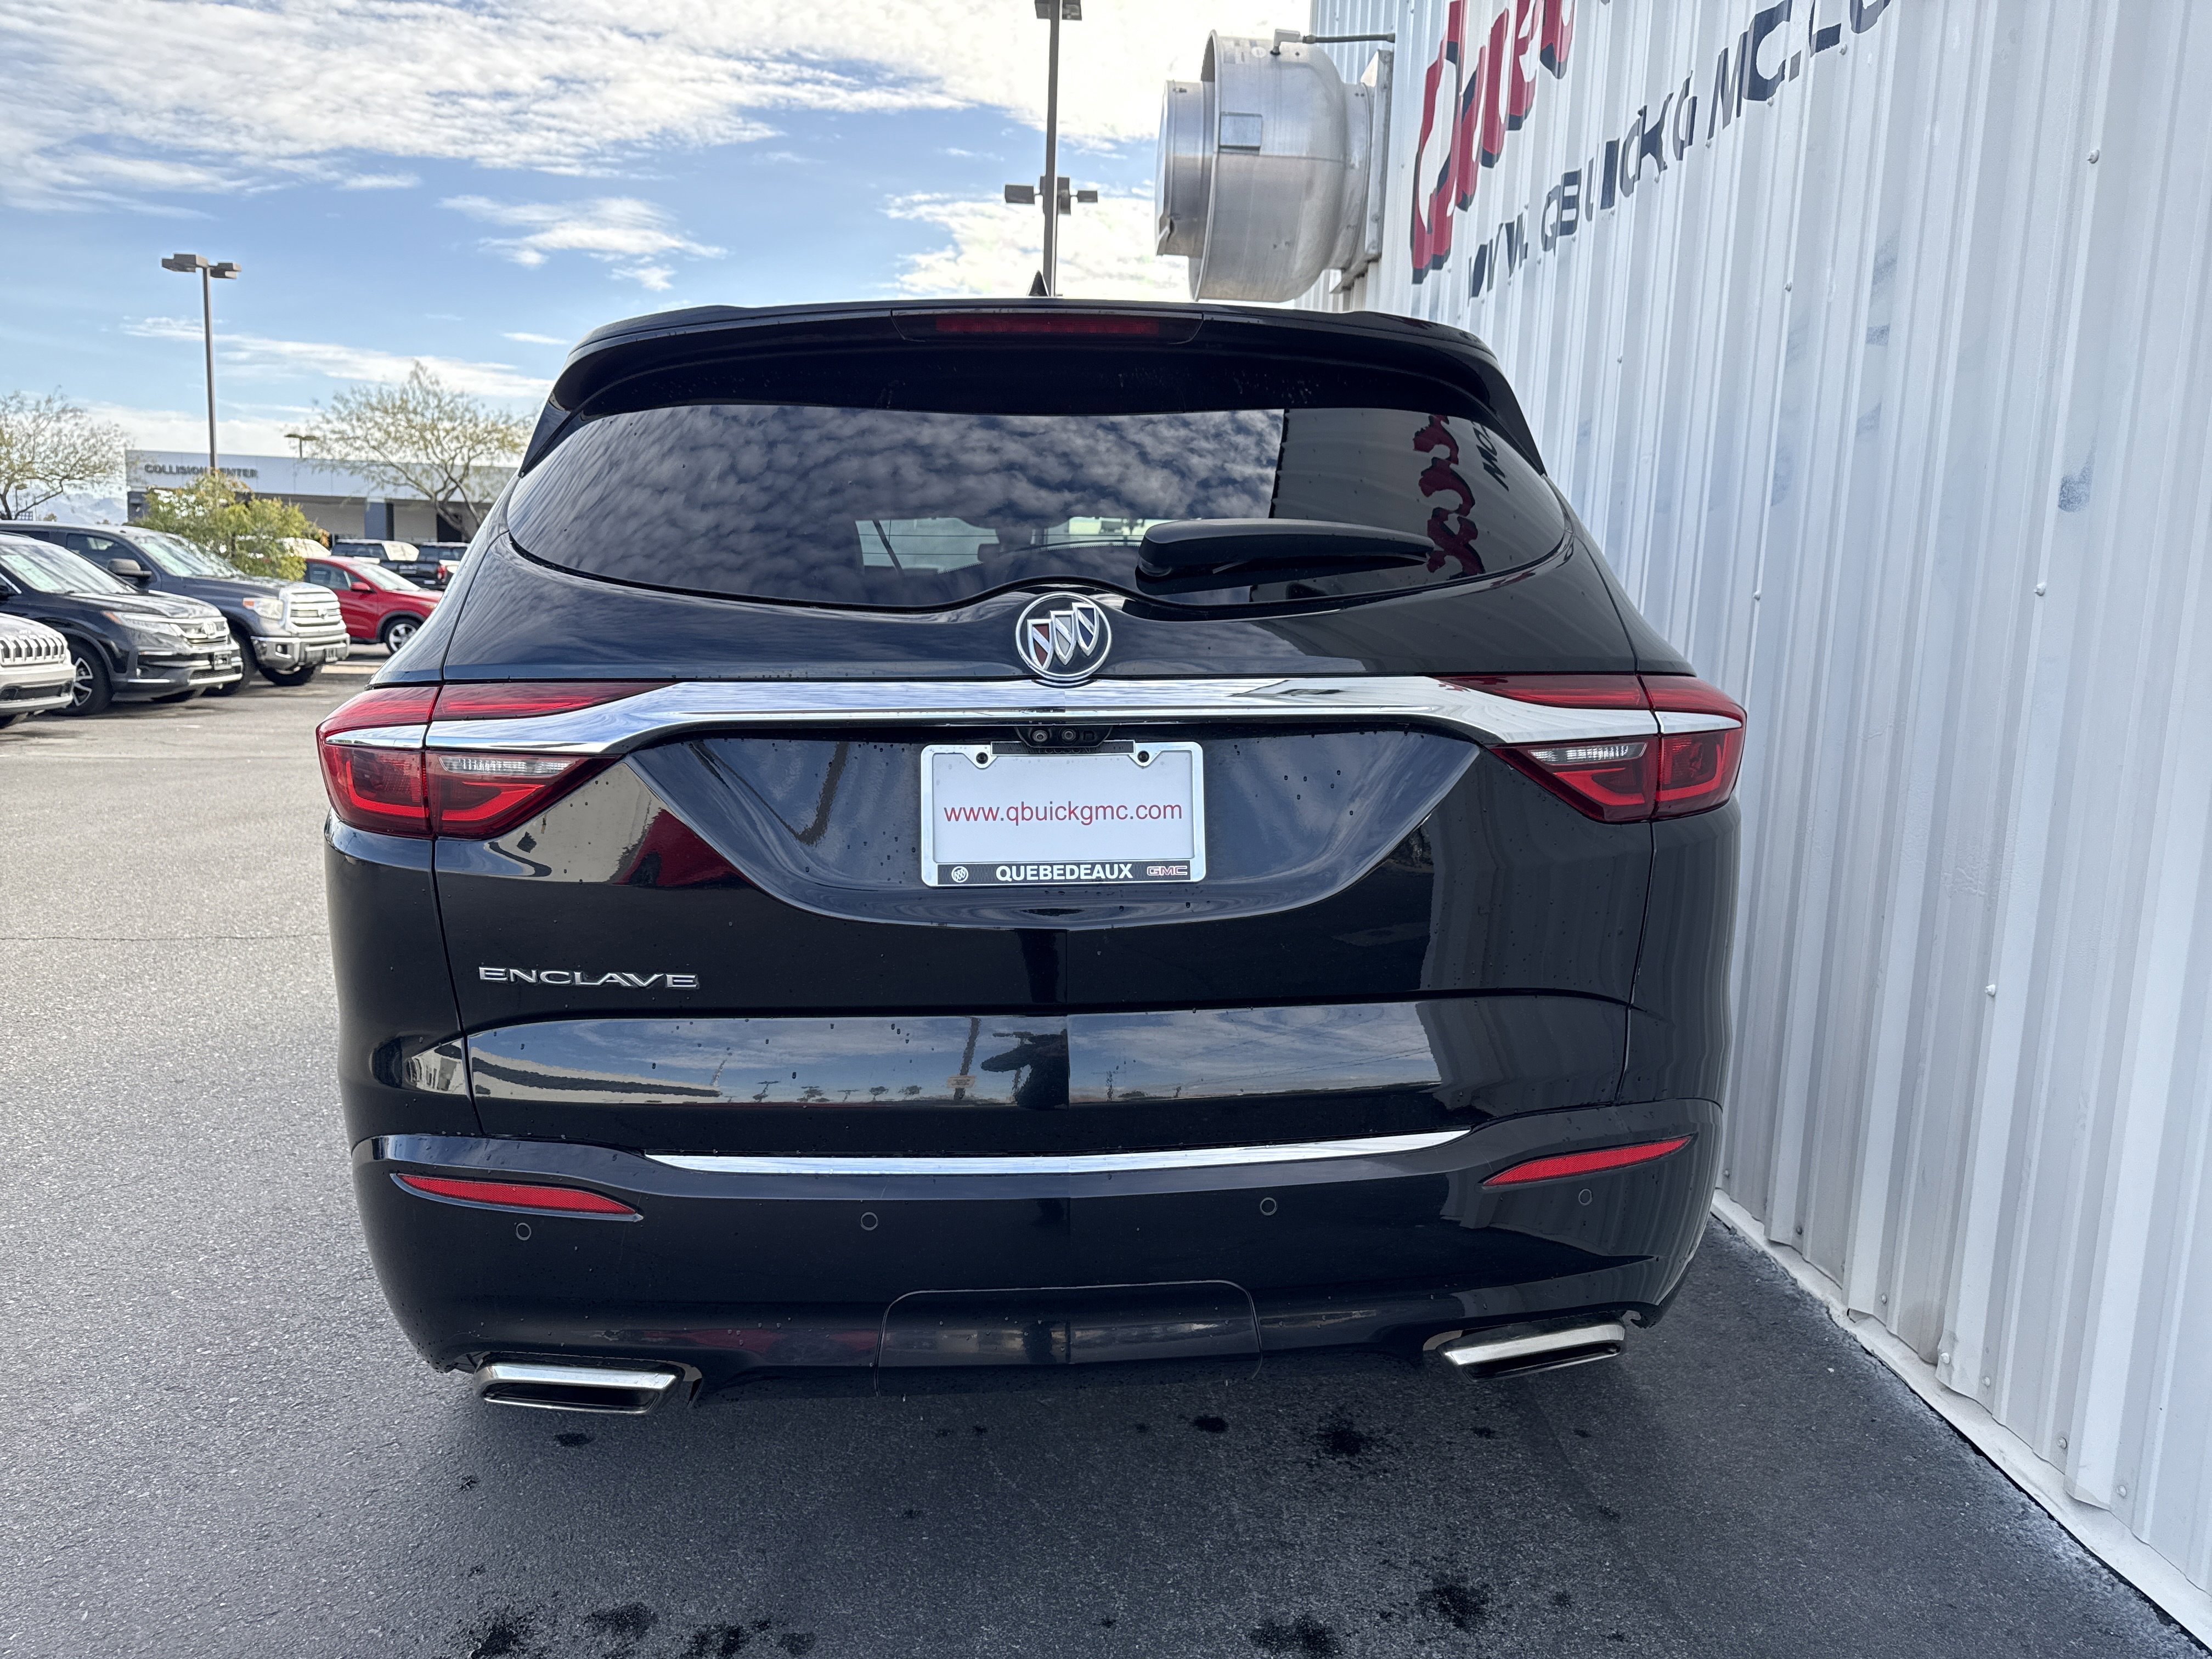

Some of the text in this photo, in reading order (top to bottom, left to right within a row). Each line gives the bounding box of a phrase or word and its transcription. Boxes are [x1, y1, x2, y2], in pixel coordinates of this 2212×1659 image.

[215, 467, 258, 478] ENTER
[944, 801, 1182, 826] www.qbuickgmc.com
[996, 864, 1188, 881] QUEBEDEAUX GMC
[478, 966, 698, 988] ENCLAVE
